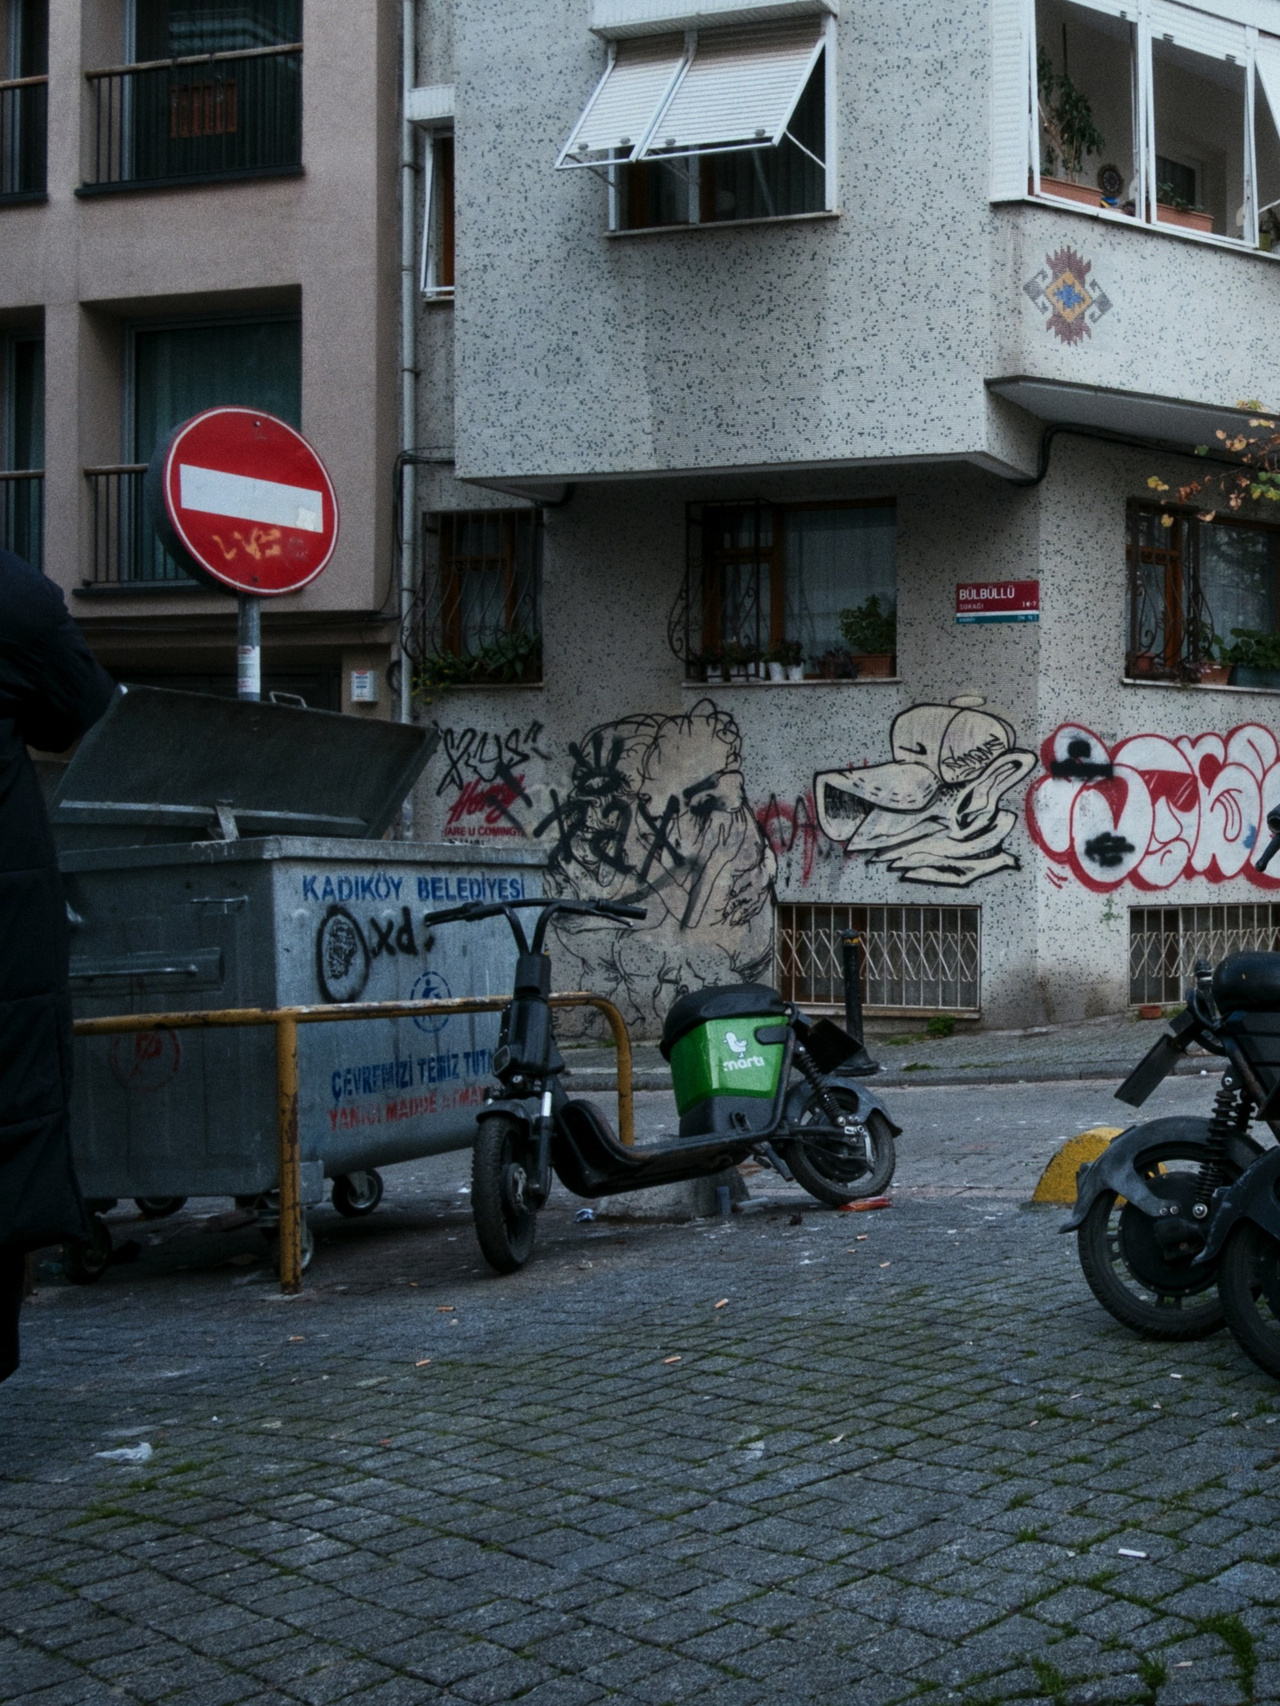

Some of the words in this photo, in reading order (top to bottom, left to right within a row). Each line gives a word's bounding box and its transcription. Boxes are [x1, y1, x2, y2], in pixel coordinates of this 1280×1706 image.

[959, 585, 1015, 600] BÜLBÜLLÜ
[302, 871, 403, 901] KADIKÖY
[417, 871, 525, 901] BELEDİYESİ
